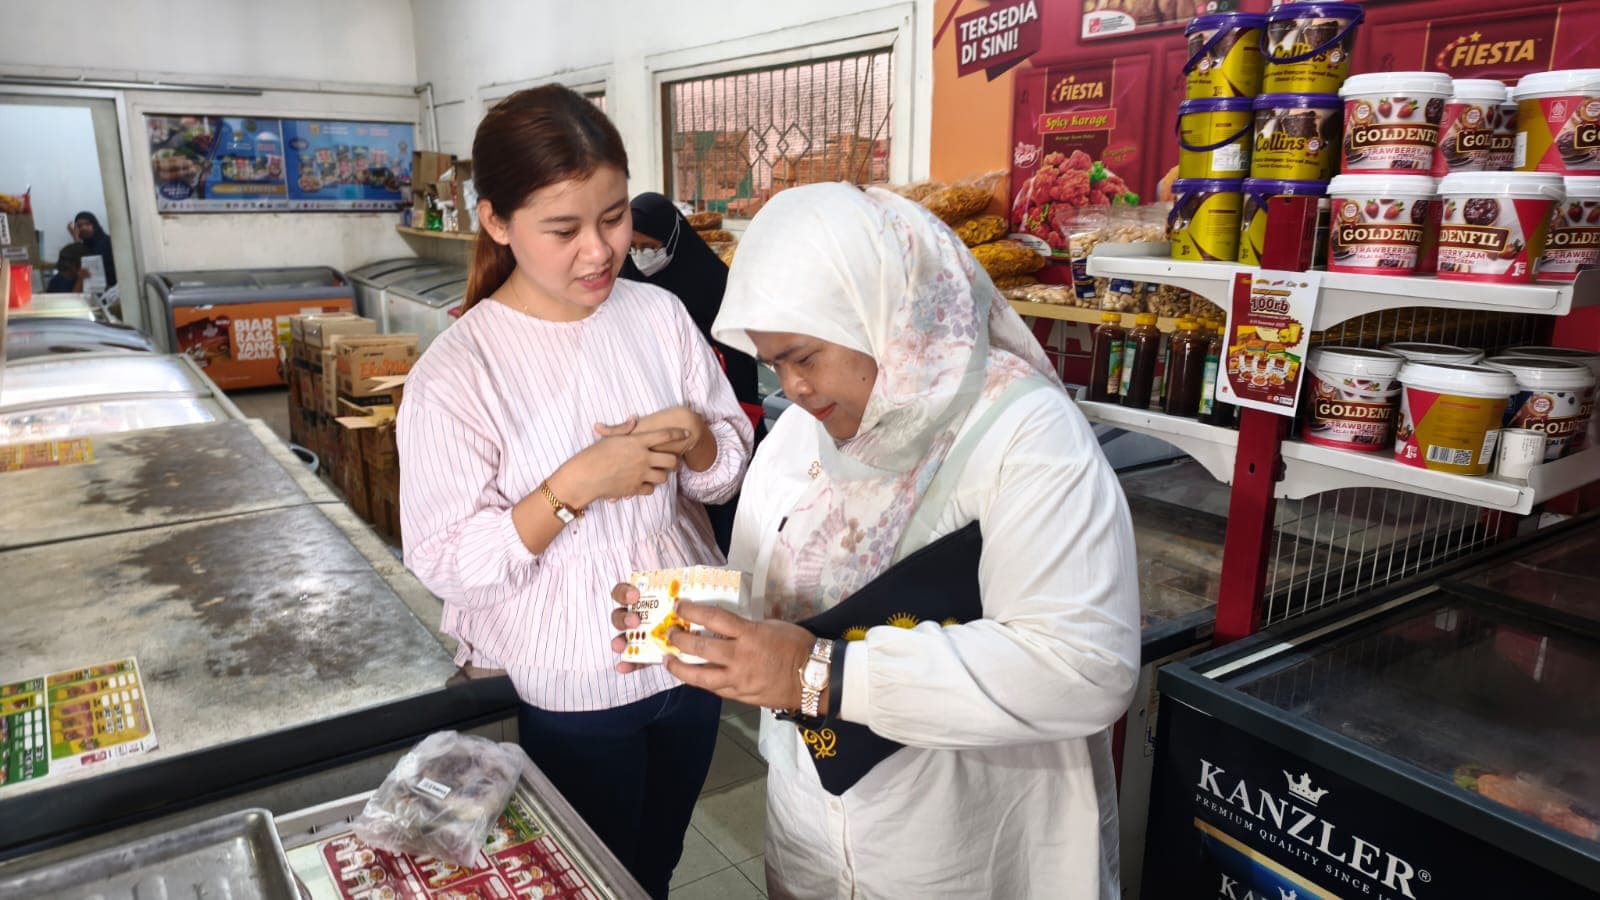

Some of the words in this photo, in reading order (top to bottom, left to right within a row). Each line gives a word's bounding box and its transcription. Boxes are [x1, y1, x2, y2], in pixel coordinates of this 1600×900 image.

[960, 0, 1038, 42] TERSEDIA
[961, 42, 977, 65] DI
[980, 28, 1019, 59] SINI!
[1272, 42, 1327, 62] Colls
[1450, 39, 1535, 68] FIESTA
[1059, 81, 1104, 102] FIESTA
[1046, 117, 1069, 130] Spicy
[1255, 131, 1305, 152] Collins
[1491, 137, 1514, 150] LD
[1582, 129, 1600, 143] G
[1439, 230, 1500, 247] DENFIL
[1250, 295, 1290, 314] 100rb
[234, 318, 273, 331] BIAR
[235, 331, 274, 342] RASA
[237, 341, 275, 352] YANG
[1197, 758, 1417, 899] KANZLER
[1195, 794, 1253, 831] PREMIUM
[1259, 829, 1319, 866] QUALITY
[1325, 864, 1371, 894] SINCE
